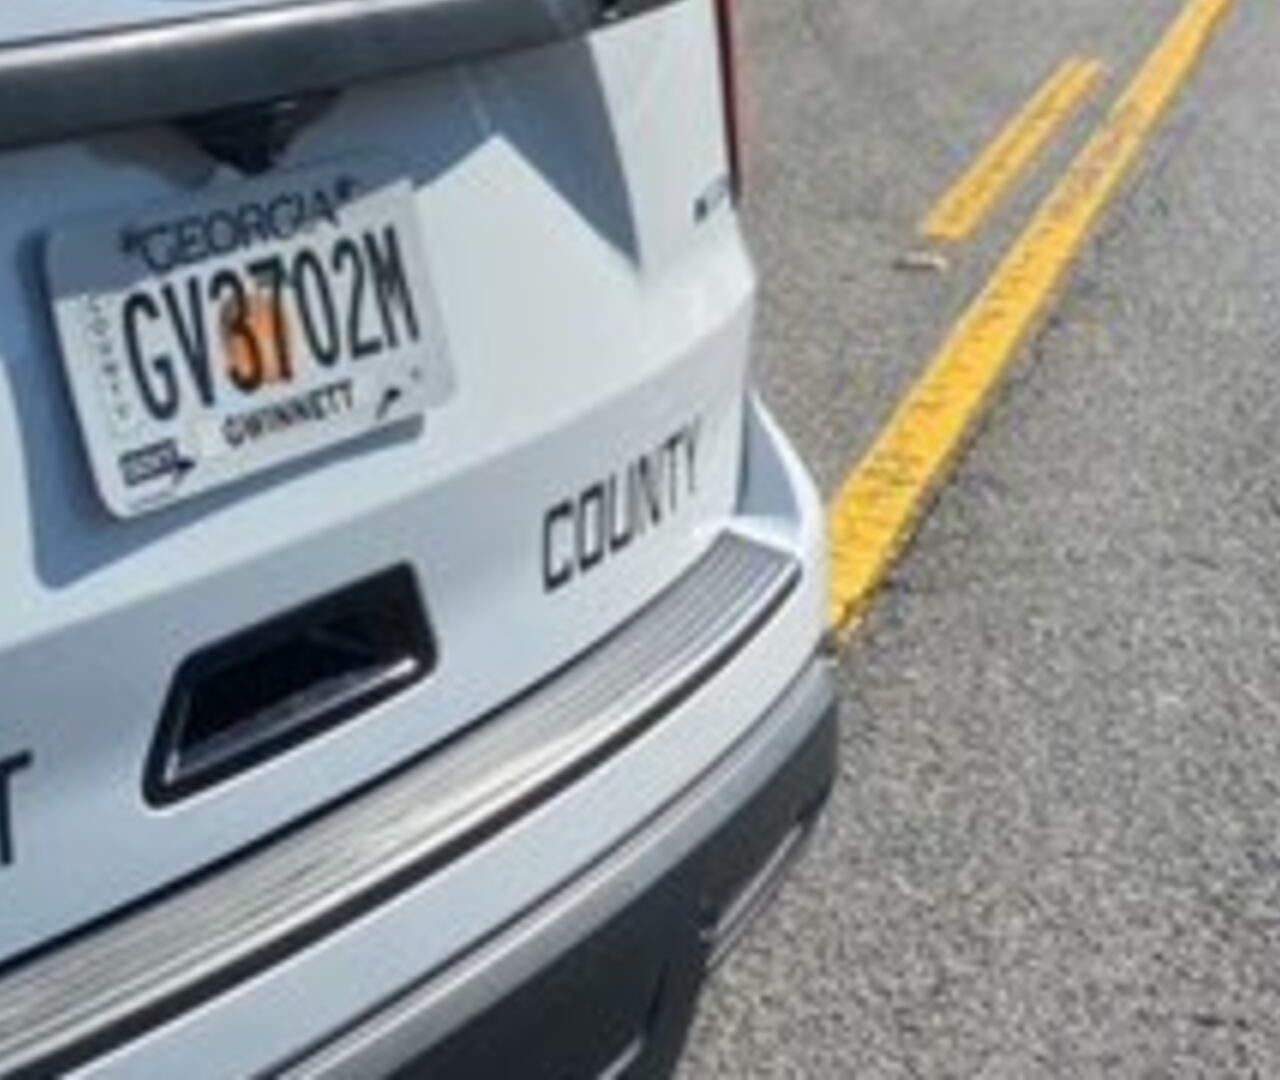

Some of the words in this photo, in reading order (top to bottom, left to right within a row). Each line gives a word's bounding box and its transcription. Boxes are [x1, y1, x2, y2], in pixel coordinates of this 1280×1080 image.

[140, 189, 340, 272] GEORGIA
[122, 224, 420, 421] GV3702M
[223, 379, 354, 447] GWINNETT
[542, 413, 699, 594] COUNTY
